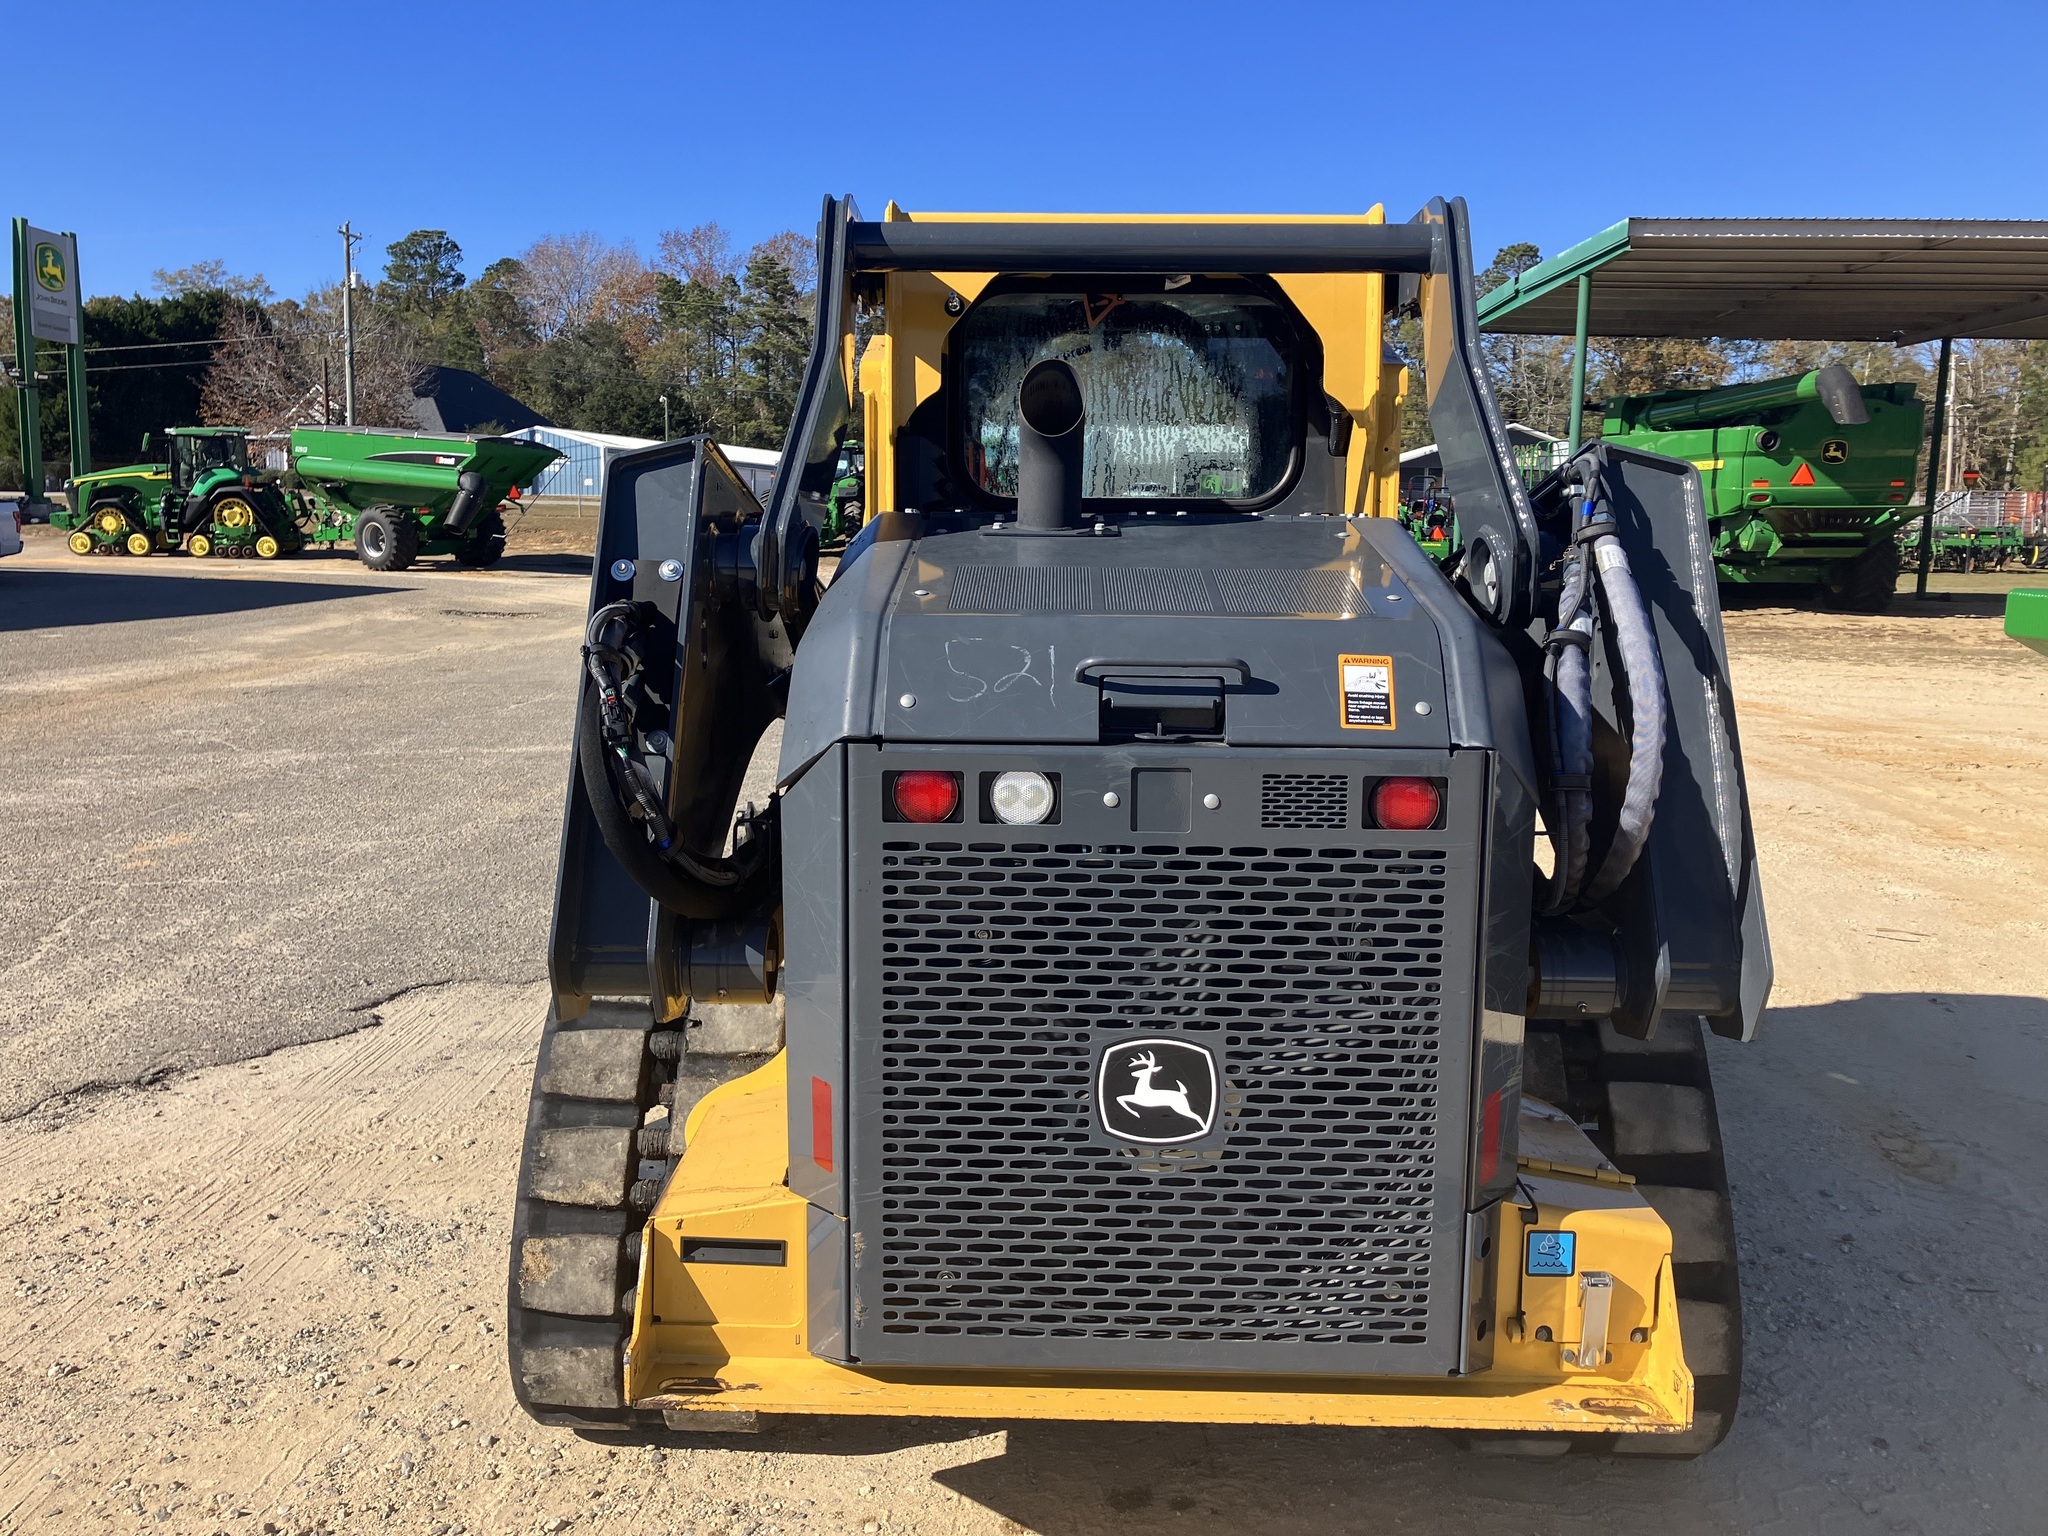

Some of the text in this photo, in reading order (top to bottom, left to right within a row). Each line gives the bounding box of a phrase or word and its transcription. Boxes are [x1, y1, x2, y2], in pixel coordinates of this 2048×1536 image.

[50, 296, 68, 307] DEERE
[1351, 657, 1389, 665] WARNING
[944, 637, 1056, 708] 521
